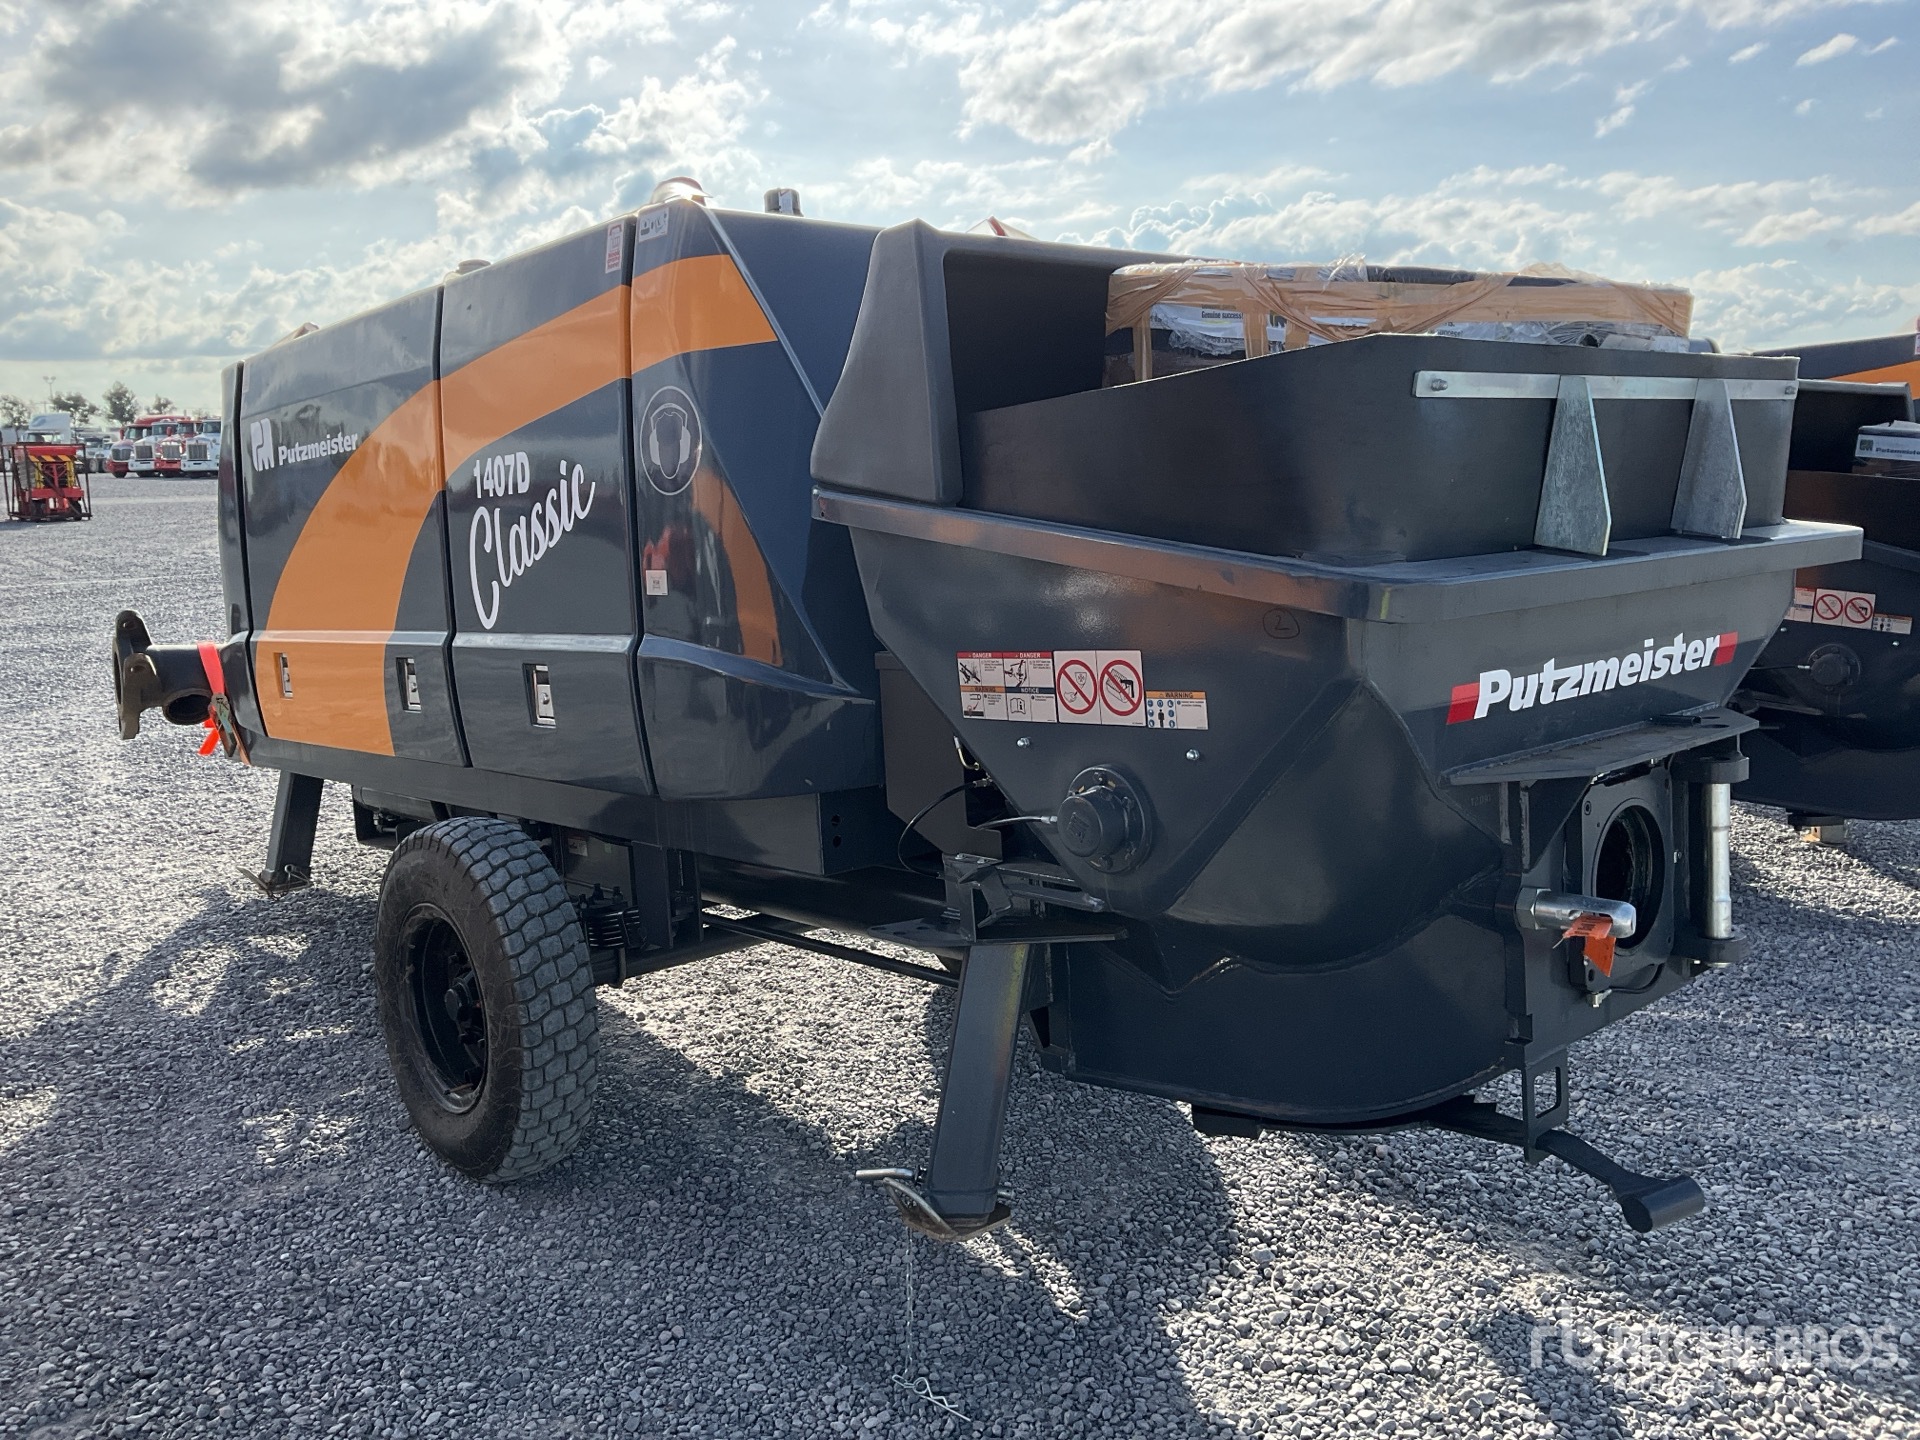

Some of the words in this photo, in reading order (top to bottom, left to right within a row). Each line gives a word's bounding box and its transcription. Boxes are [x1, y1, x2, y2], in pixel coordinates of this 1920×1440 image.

[1201, 310, 1221, 319] Genuine
[1222, 312, 1244, 320] success!
[278, 432, 358, 466] Putzmeister
[473, 451, 531, 498] 1407D
[469, 459, 596, 630] Classic
[1473, 632, 1721, 720] Putzmeister
